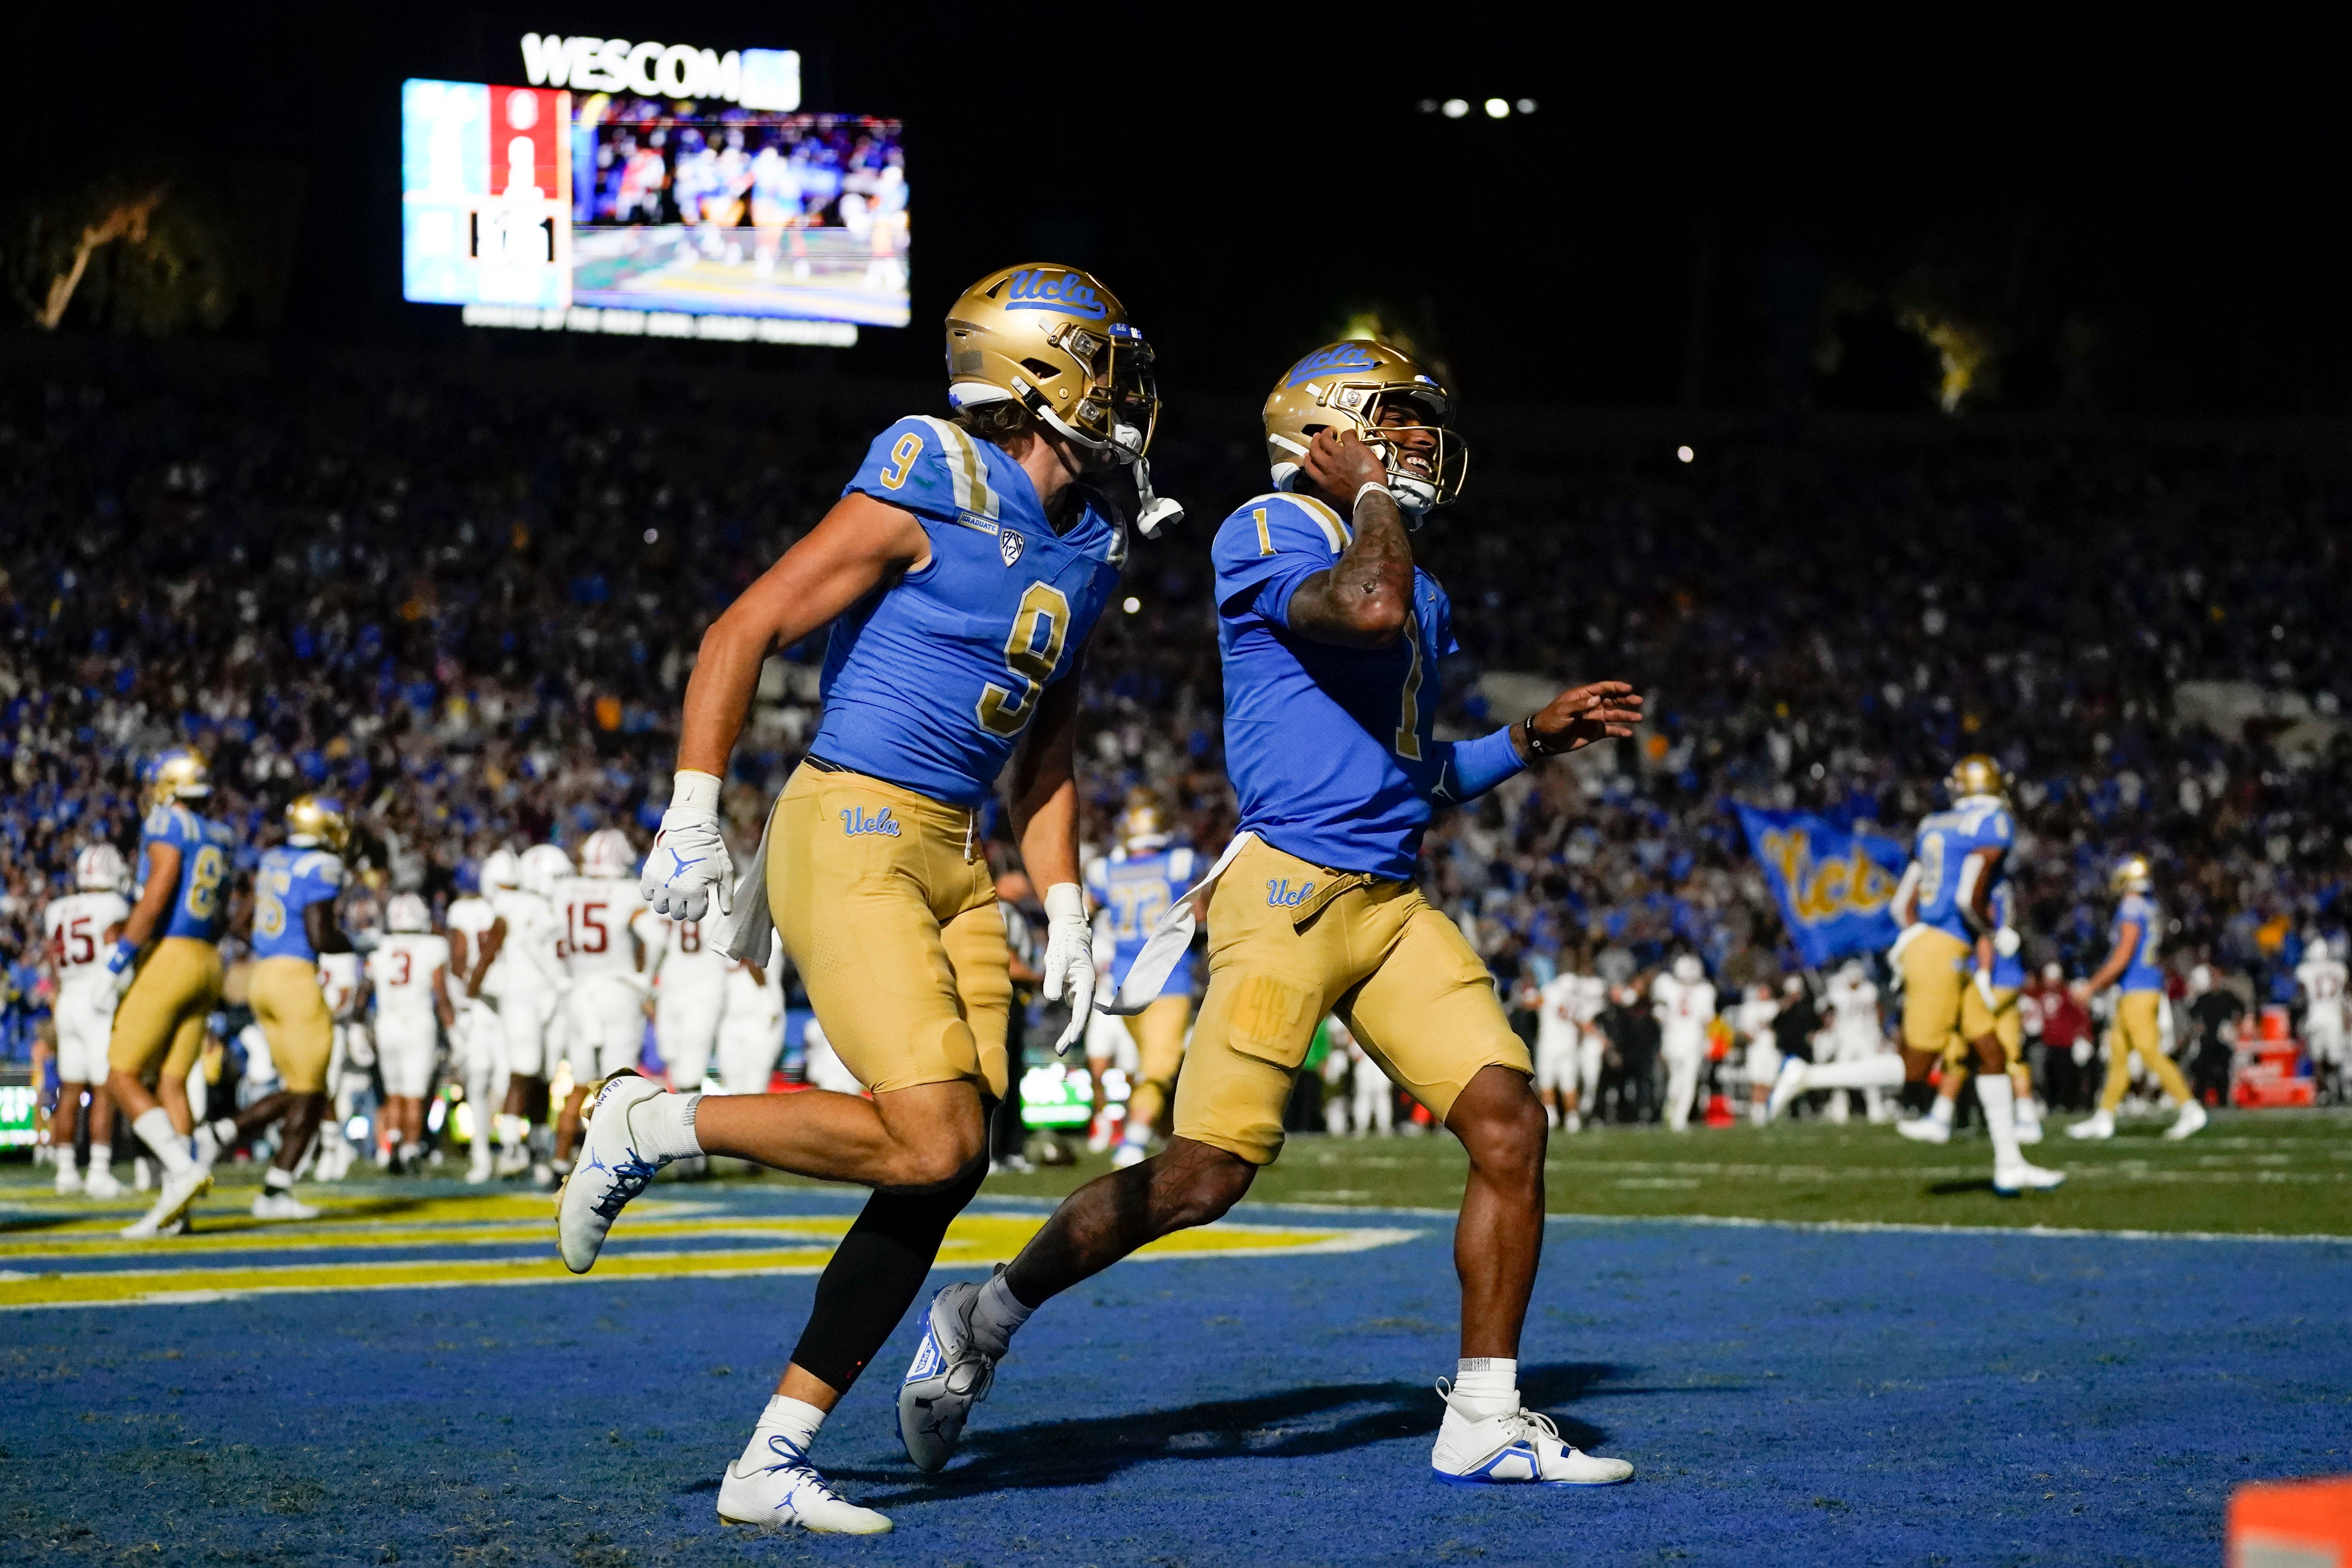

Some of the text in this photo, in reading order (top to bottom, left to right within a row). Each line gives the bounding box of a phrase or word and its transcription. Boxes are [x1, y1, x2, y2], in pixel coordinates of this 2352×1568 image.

[521, 32, 742, 102] WESCOM
[880, 432, 923, 490] 9
[962, 516, 996, 532] GRADUATE
[1002, 531, 1023, 554] PAC
[1253, 508, 1277, 557] 1
[1005, 545, 1016, 559] 12
[975, 581, 1071, 738] 9
[1396, 610, 1423, 762] 1
[1267, 878, 1315, 908] Ucl
[566, 902, 609, 954] 15
[390, 950, 411, 986] 3
[915, 1340, 932, 1373] ALPHA
